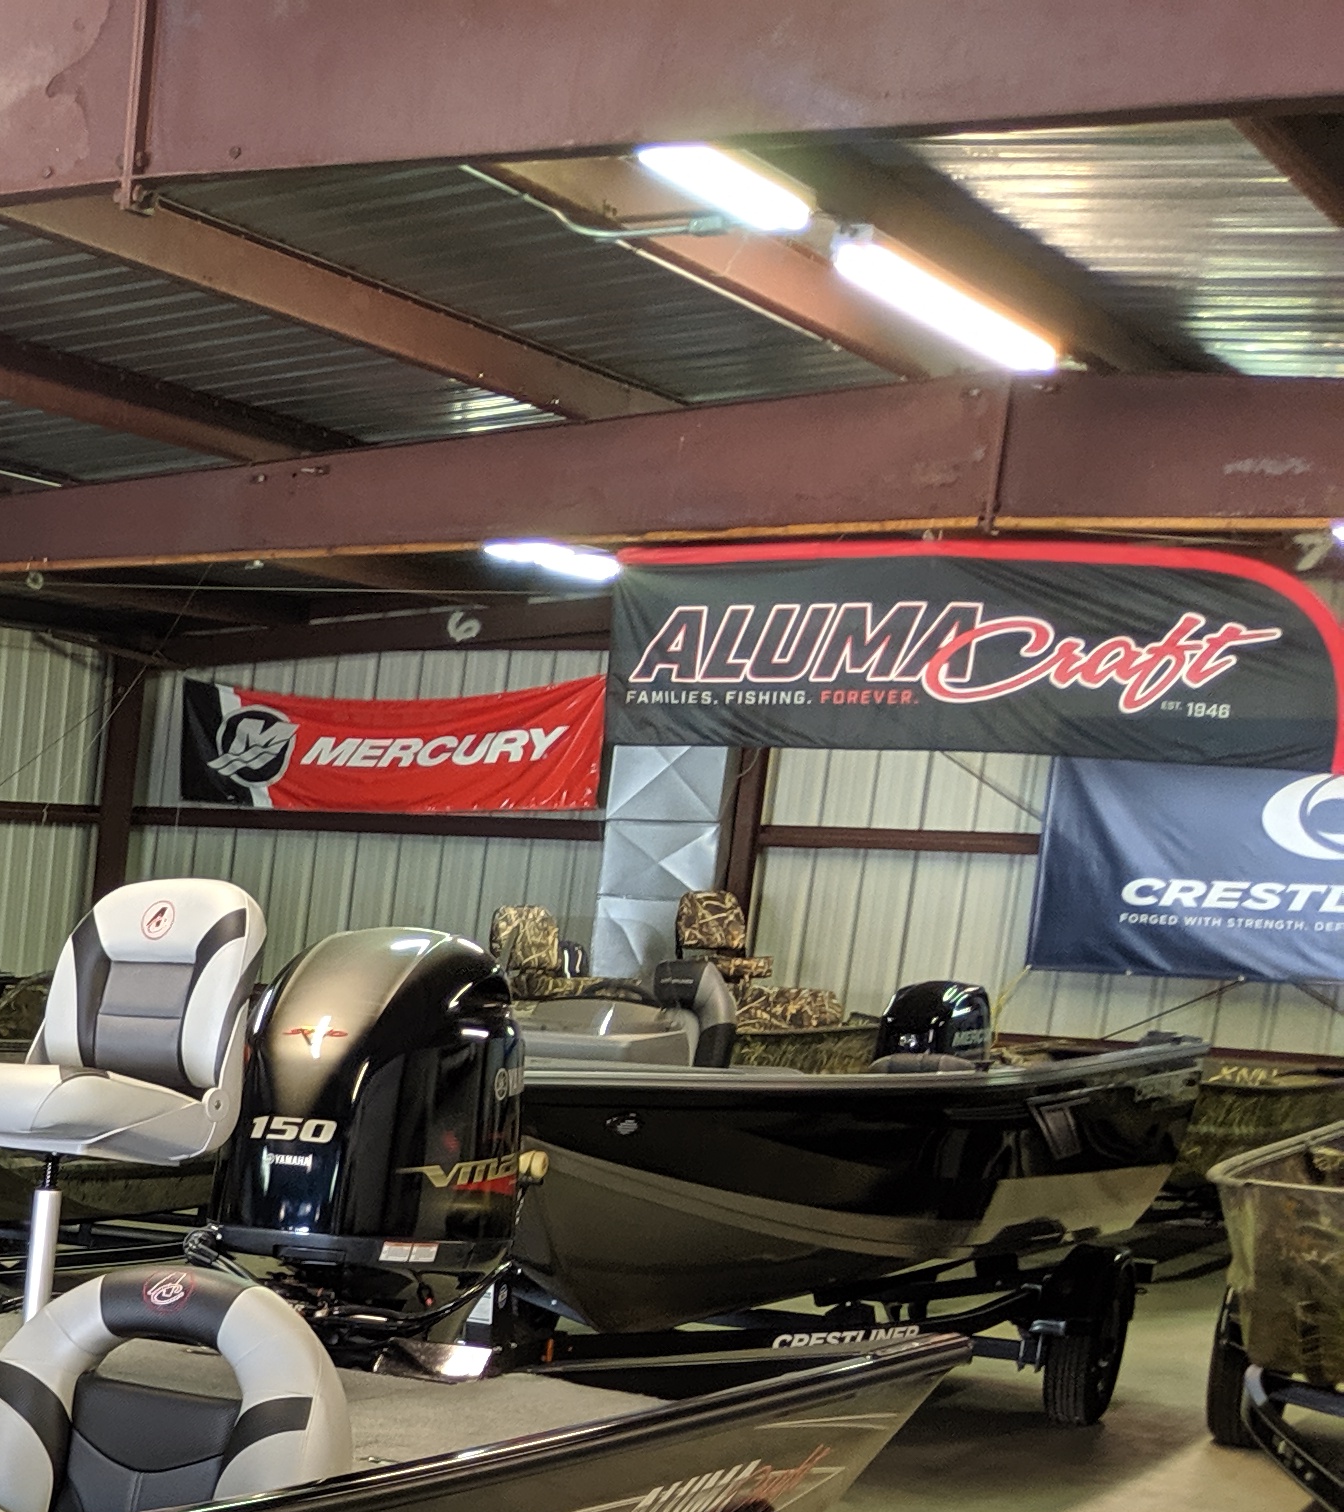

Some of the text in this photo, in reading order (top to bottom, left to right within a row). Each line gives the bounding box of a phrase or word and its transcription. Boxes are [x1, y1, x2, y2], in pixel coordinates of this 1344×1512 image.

[626, 689, 919, 705] FAMILIES. FISHING. FOREVER.
[300, 725, 569, 768] MERCURY
[1119, 912, 1179, 926] FORGED
[1184, 916, 1222, 928] WITH
[1227, 918, 1308, 931] STRENGTH.
[250, 1116, 338, 1143] 150
[275, 1154, 313, 1167] YAMAHA
